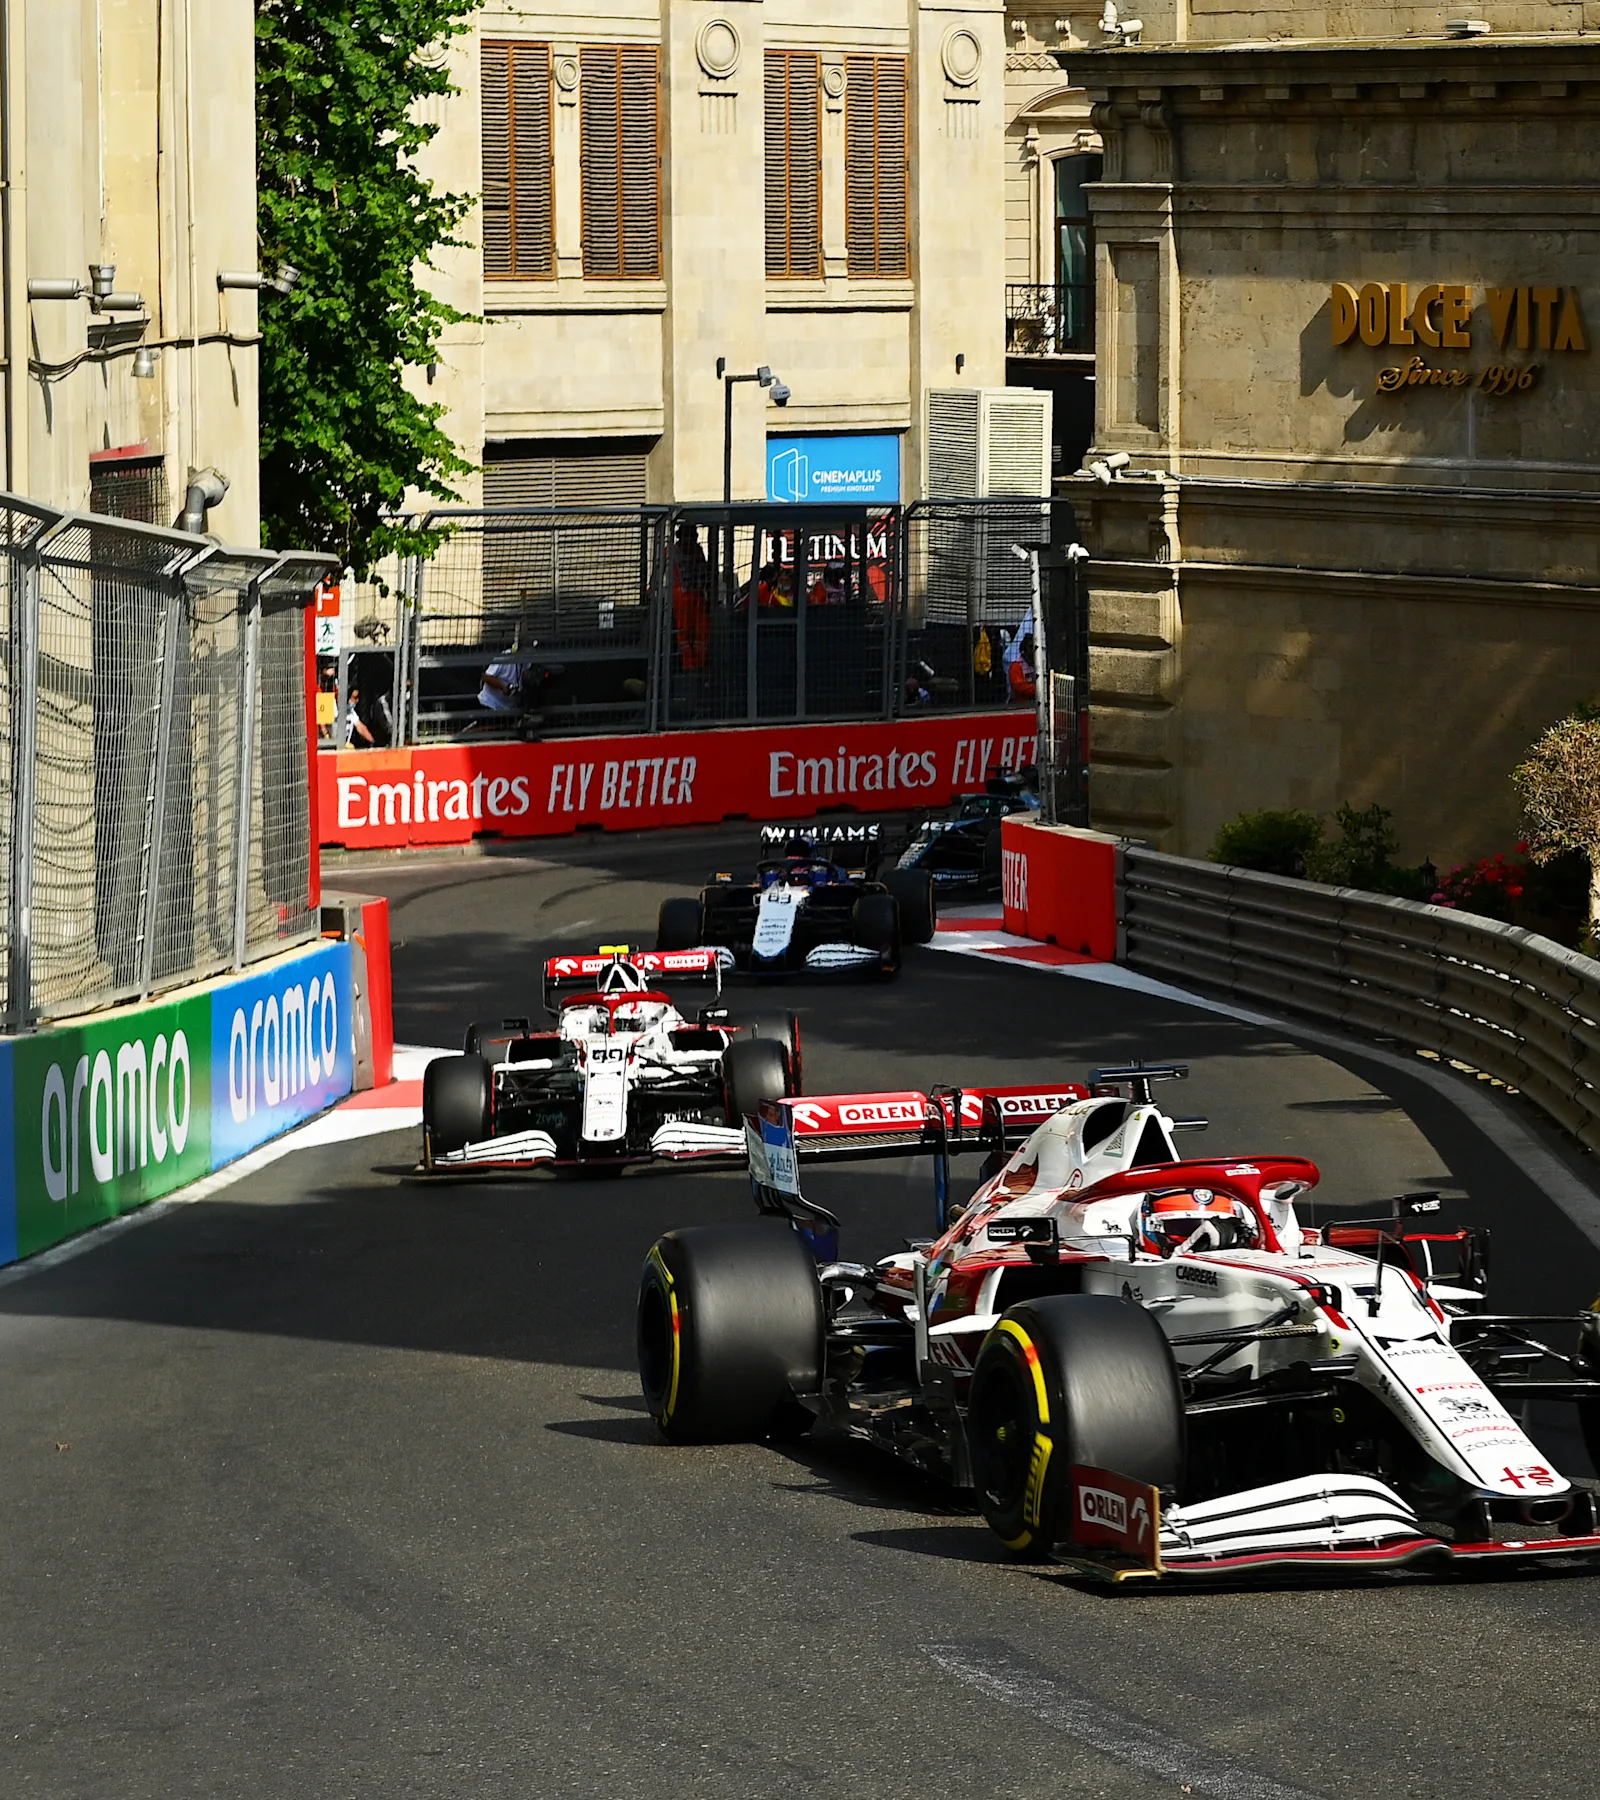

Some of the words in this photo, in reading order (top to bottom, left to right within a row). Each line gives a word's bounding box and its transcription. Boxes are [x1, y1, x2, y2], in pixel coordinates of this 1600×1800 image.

[1331, 282, 1473, 348] DOLCE
[1484, 286, 1588, 350] VITA
[1375, 356, 1468, 394] Since
[1475, 363, 1540, 396] 1996
[812, 470, 881, 484] CINEMAPLUS
[767, 531, 887, 562] LTINUM
[768, 746, 937, 798] Emirates
[952, 737, 994, 785] FLY
[337, 770, 528, 828] Emirates
[548, 763, 594, 813] FLY
[600, 757, 697, 810] BETTER
[667, 957, 705, 968] ORLEN
[231, 971, 338, 1123] aramco
[41, 1029, 191, 1201] aramco
[845, 1106, 917, 1121] ORLEN
[1176, 1265, 1218, 1287] CARRERA
[1416, 1382, 1483, 1395] PIRELLI
[1442, 1412, 1510, 1424] SINGHA
[1452, 1425, 1521, 1438] CARRERA
[1083, 1490, 1126, 1529] ORLEN
